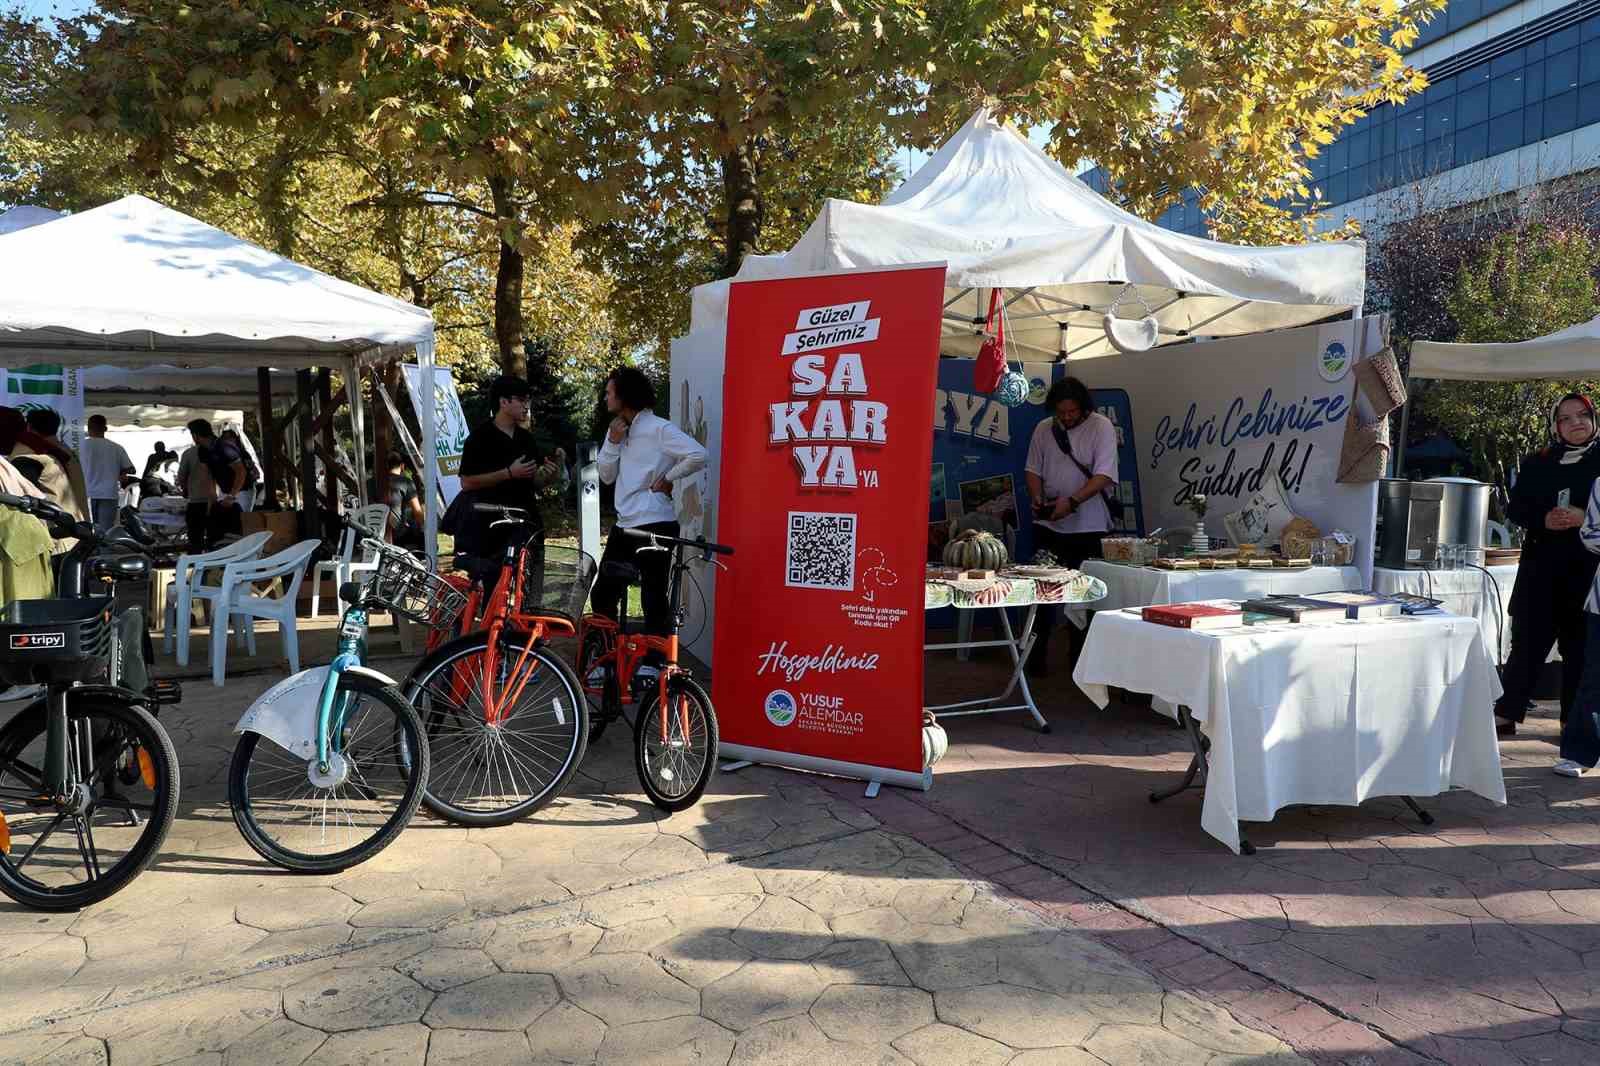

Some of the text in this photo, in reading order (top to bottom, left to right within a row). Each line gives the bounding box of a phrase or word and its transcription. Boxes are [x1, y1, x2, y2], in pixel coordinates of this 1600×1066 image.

[809, 305, 856, 326] Güzel
[795, 324, 867, 350] Şehrimiz
[791, 352, 868, 396] SA
[769, 399, 889, 445] KAR
[1151, 387, 1349, 469] Şehri Cebinize
[793, 445, 858, 489] YA
[1173, 438, 1314, 505] Sığdırdk!
[31, 635, 60, 646] tripy
[756, 640, 880, 682] Hoşgeldiniz
[799, 705, 864, 726] ALEMDAR
[800, 692, 844, 709] YUSUF
